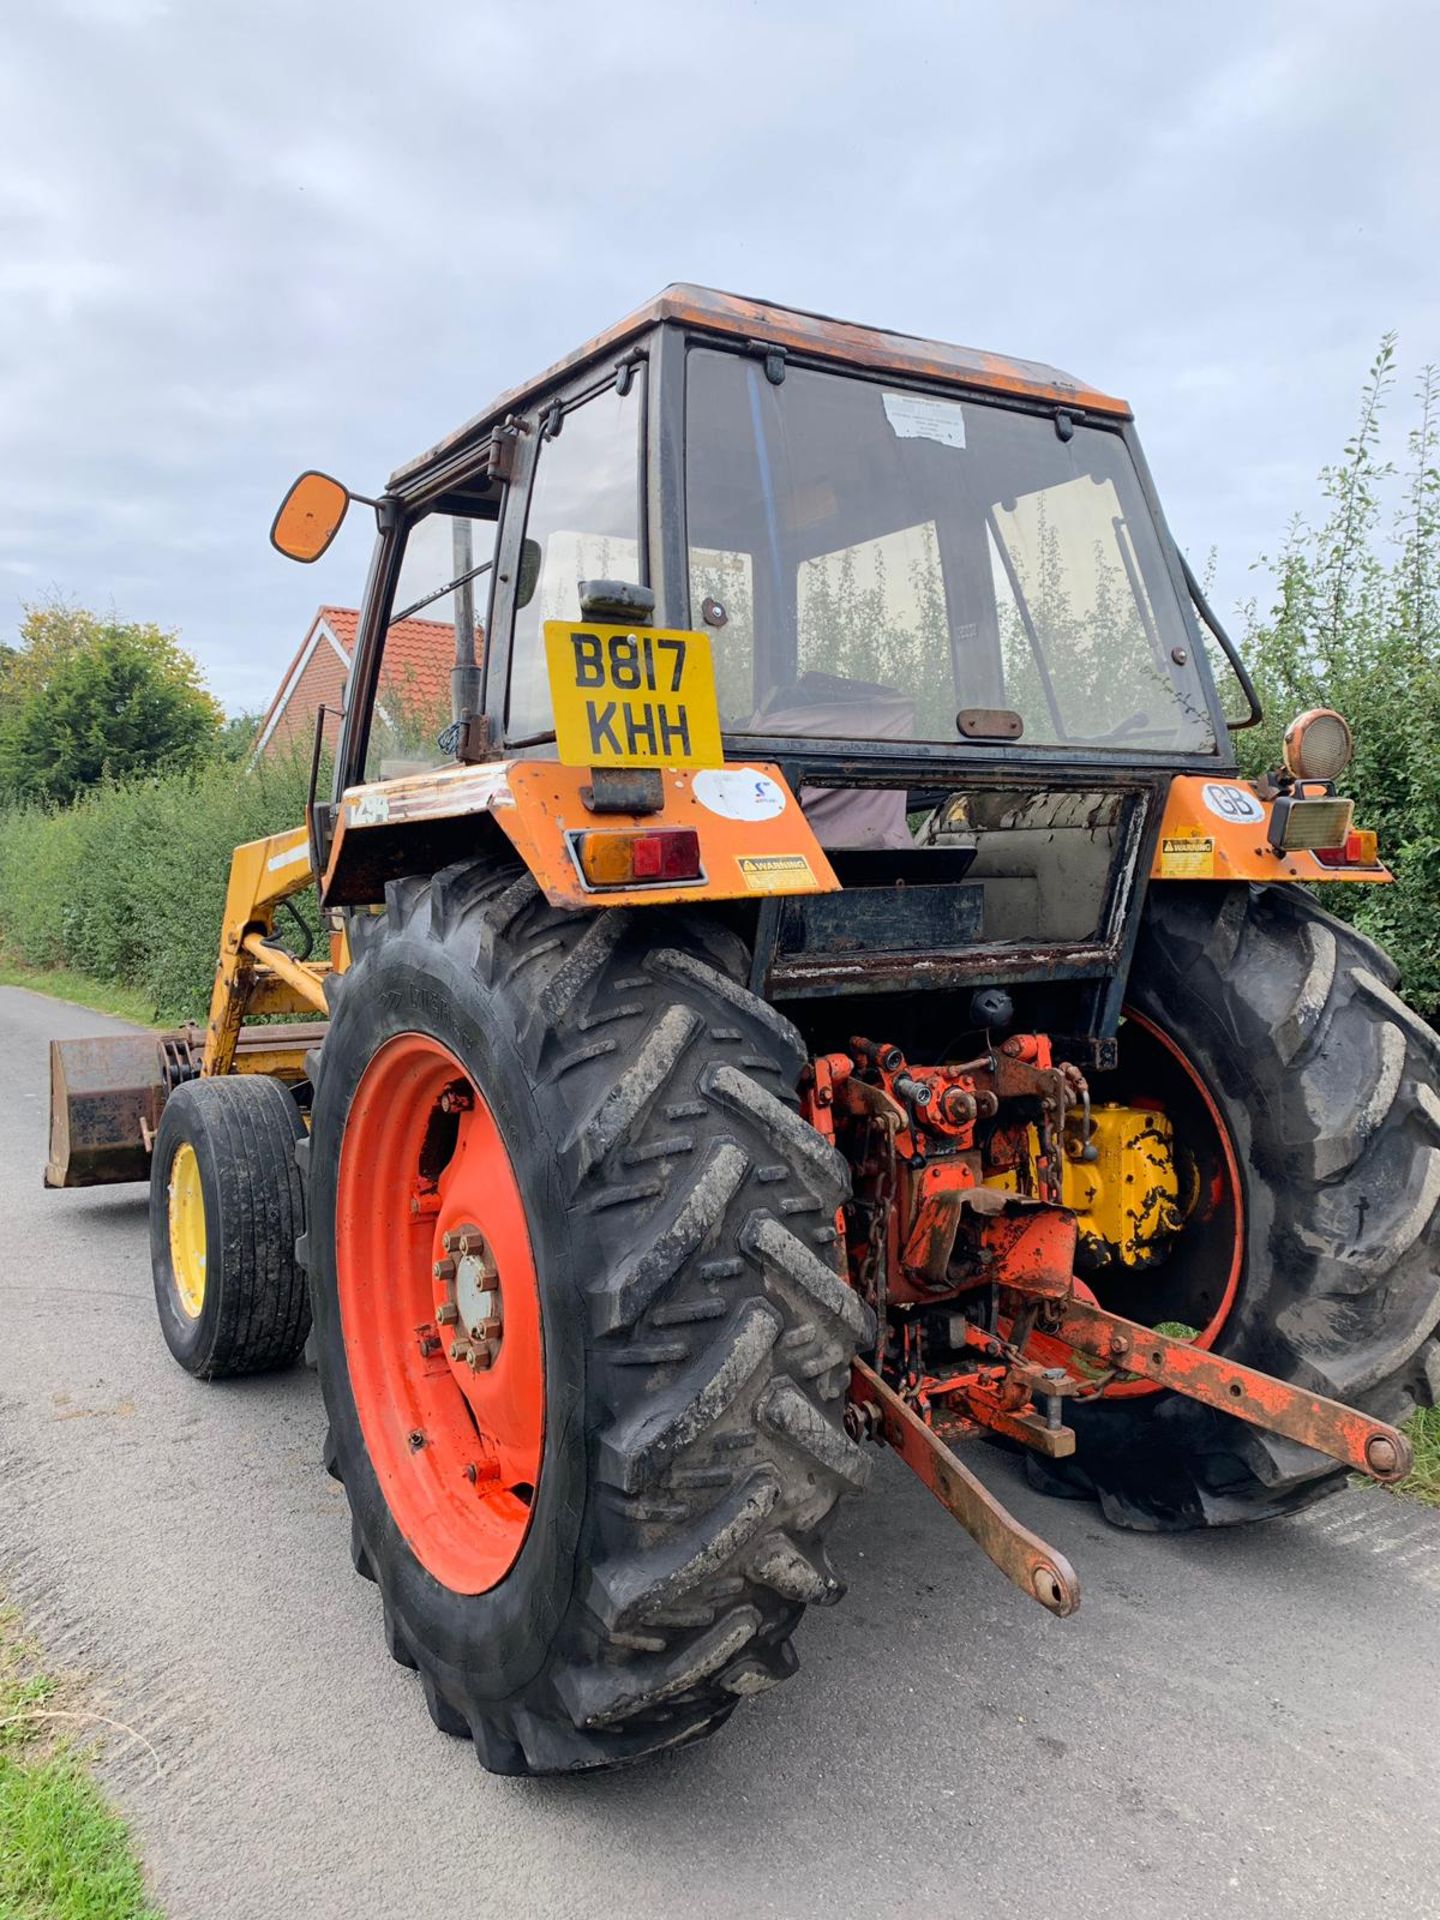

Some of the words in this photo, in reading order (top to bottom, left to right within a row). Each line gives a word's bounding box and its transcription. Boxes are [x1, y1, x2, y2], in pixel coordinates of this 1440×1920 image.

[570, 632, 687, 692] B817
[586, 700, 692, 756] KHH
[1206, 785, 1255, 815] GB
[1173, 843, 1212, 851] WARNING
[755, 860, 806, 871] WARNING
